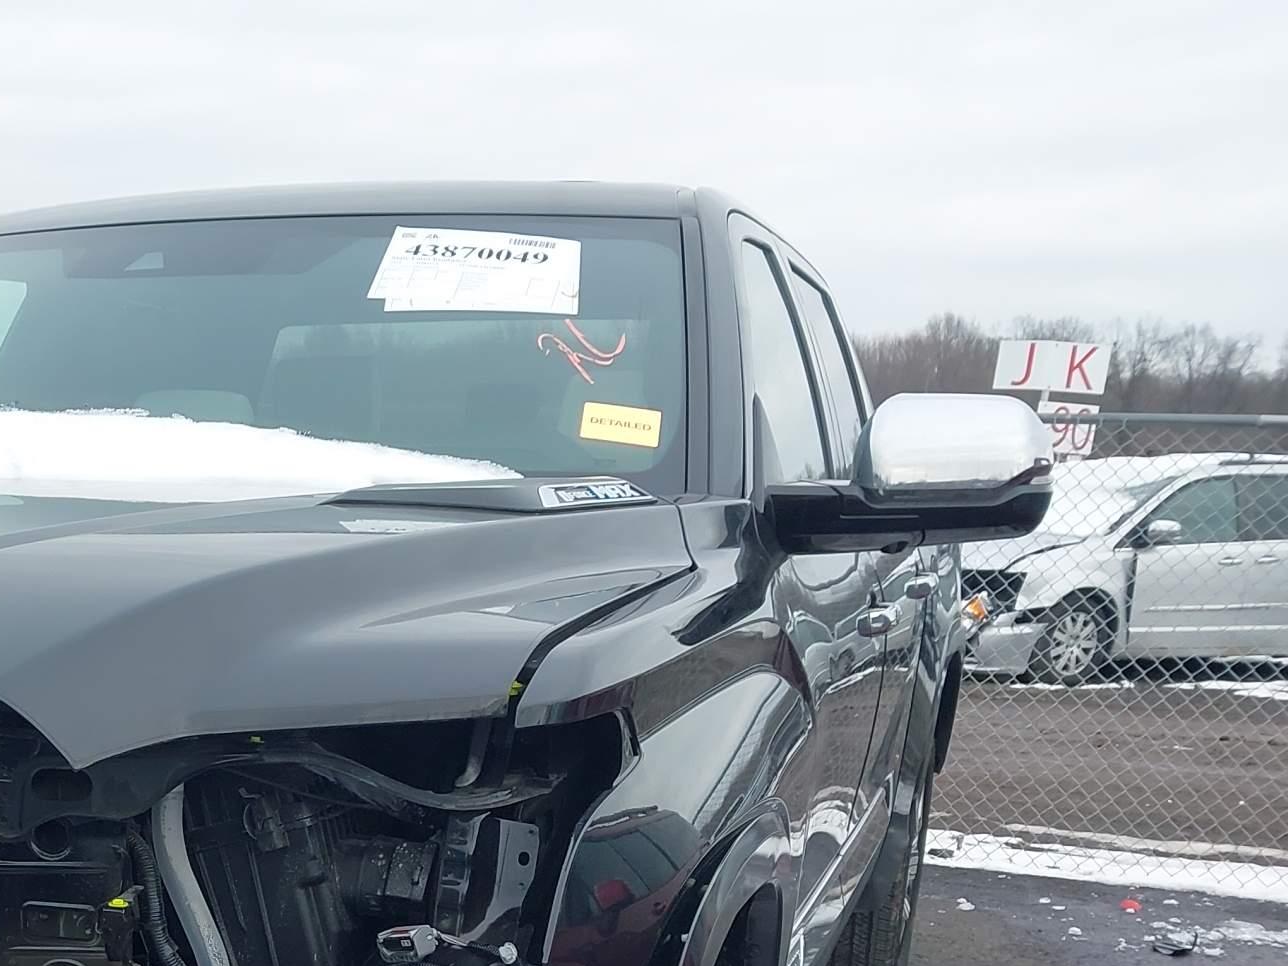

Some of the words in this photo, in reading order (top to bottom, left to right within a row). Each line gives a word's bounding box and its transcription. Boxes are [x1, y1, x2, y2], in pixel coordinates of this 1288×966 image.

[404, 243, 549, 265] 43870049
[1010, 342, 1037, 386] J
[1065, 344, 1100, 390] K
[589, 415, 653, 431] DETAILED
[1051, 405, 1093, 451] 90
